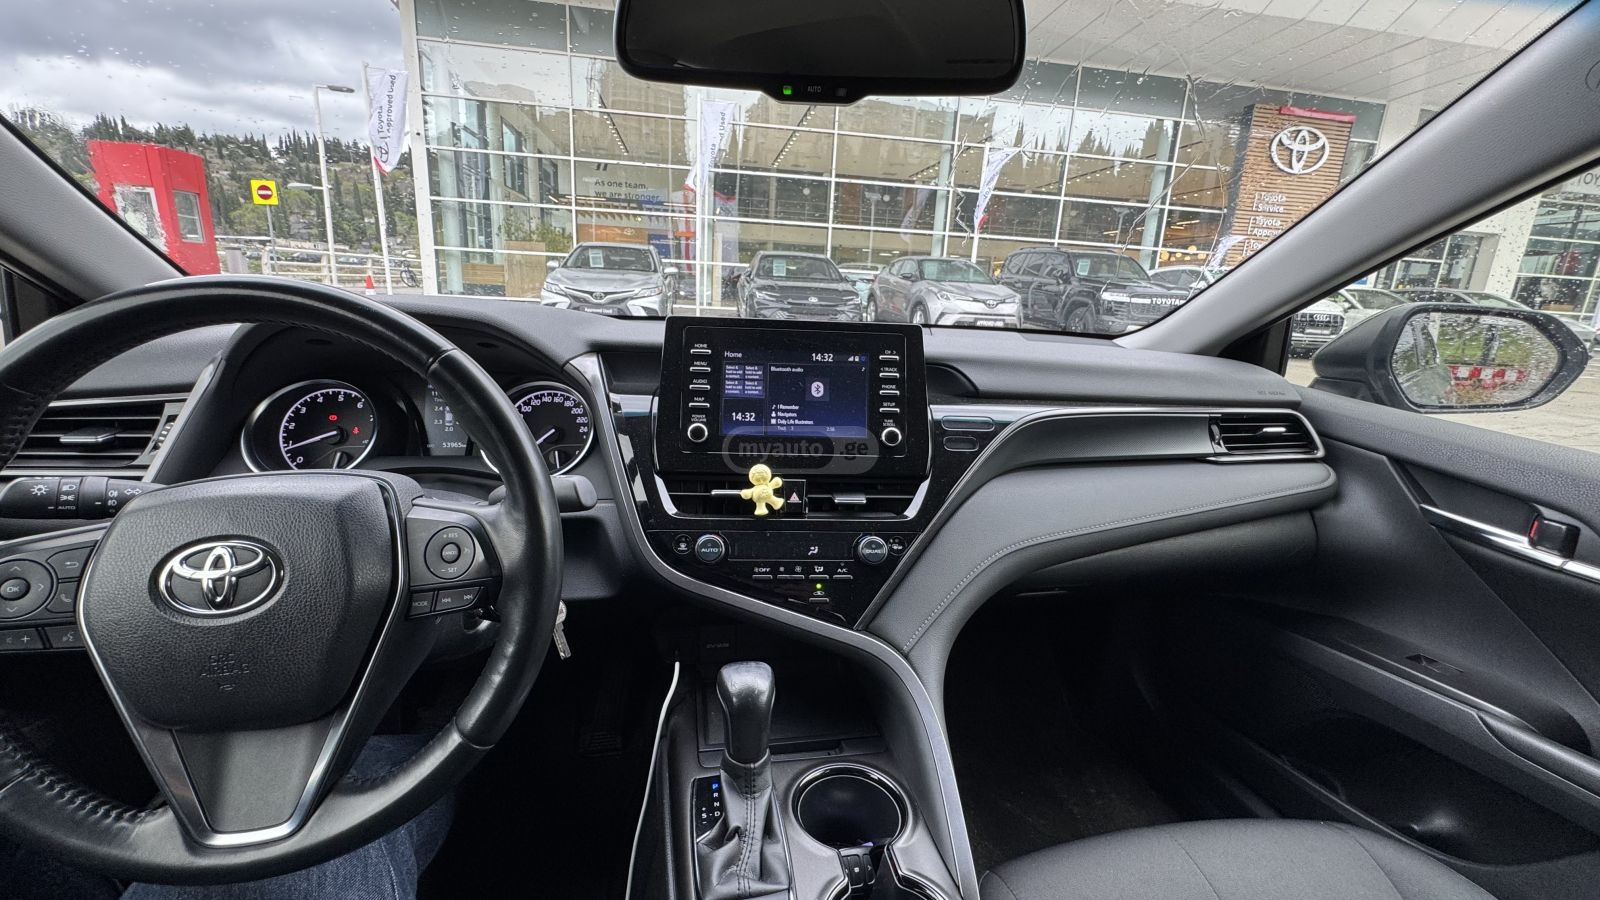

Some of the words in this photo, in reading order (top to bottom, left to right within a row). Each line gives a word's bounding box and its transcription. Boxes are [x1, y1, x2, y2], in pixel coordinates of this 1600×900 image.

[595, 179, 605, 187] As
[607, 180, 623, 188] one
[1261, 192, 1287, 203] Toyota
[1258, 203, 1285, 213] Service
[1256, 216, 1281, 227] Toyota
[1152, 298, 1180, 306] TOYOTA
[811, 353, 834, 362] 14:32
[521, 405, 532, 413] 100
[576, 416, 589, 424] 220
[731, 411, 756, 422] 14:32
[288, 422, 295, 430] 2
[296, 456, 304, 464] 0
